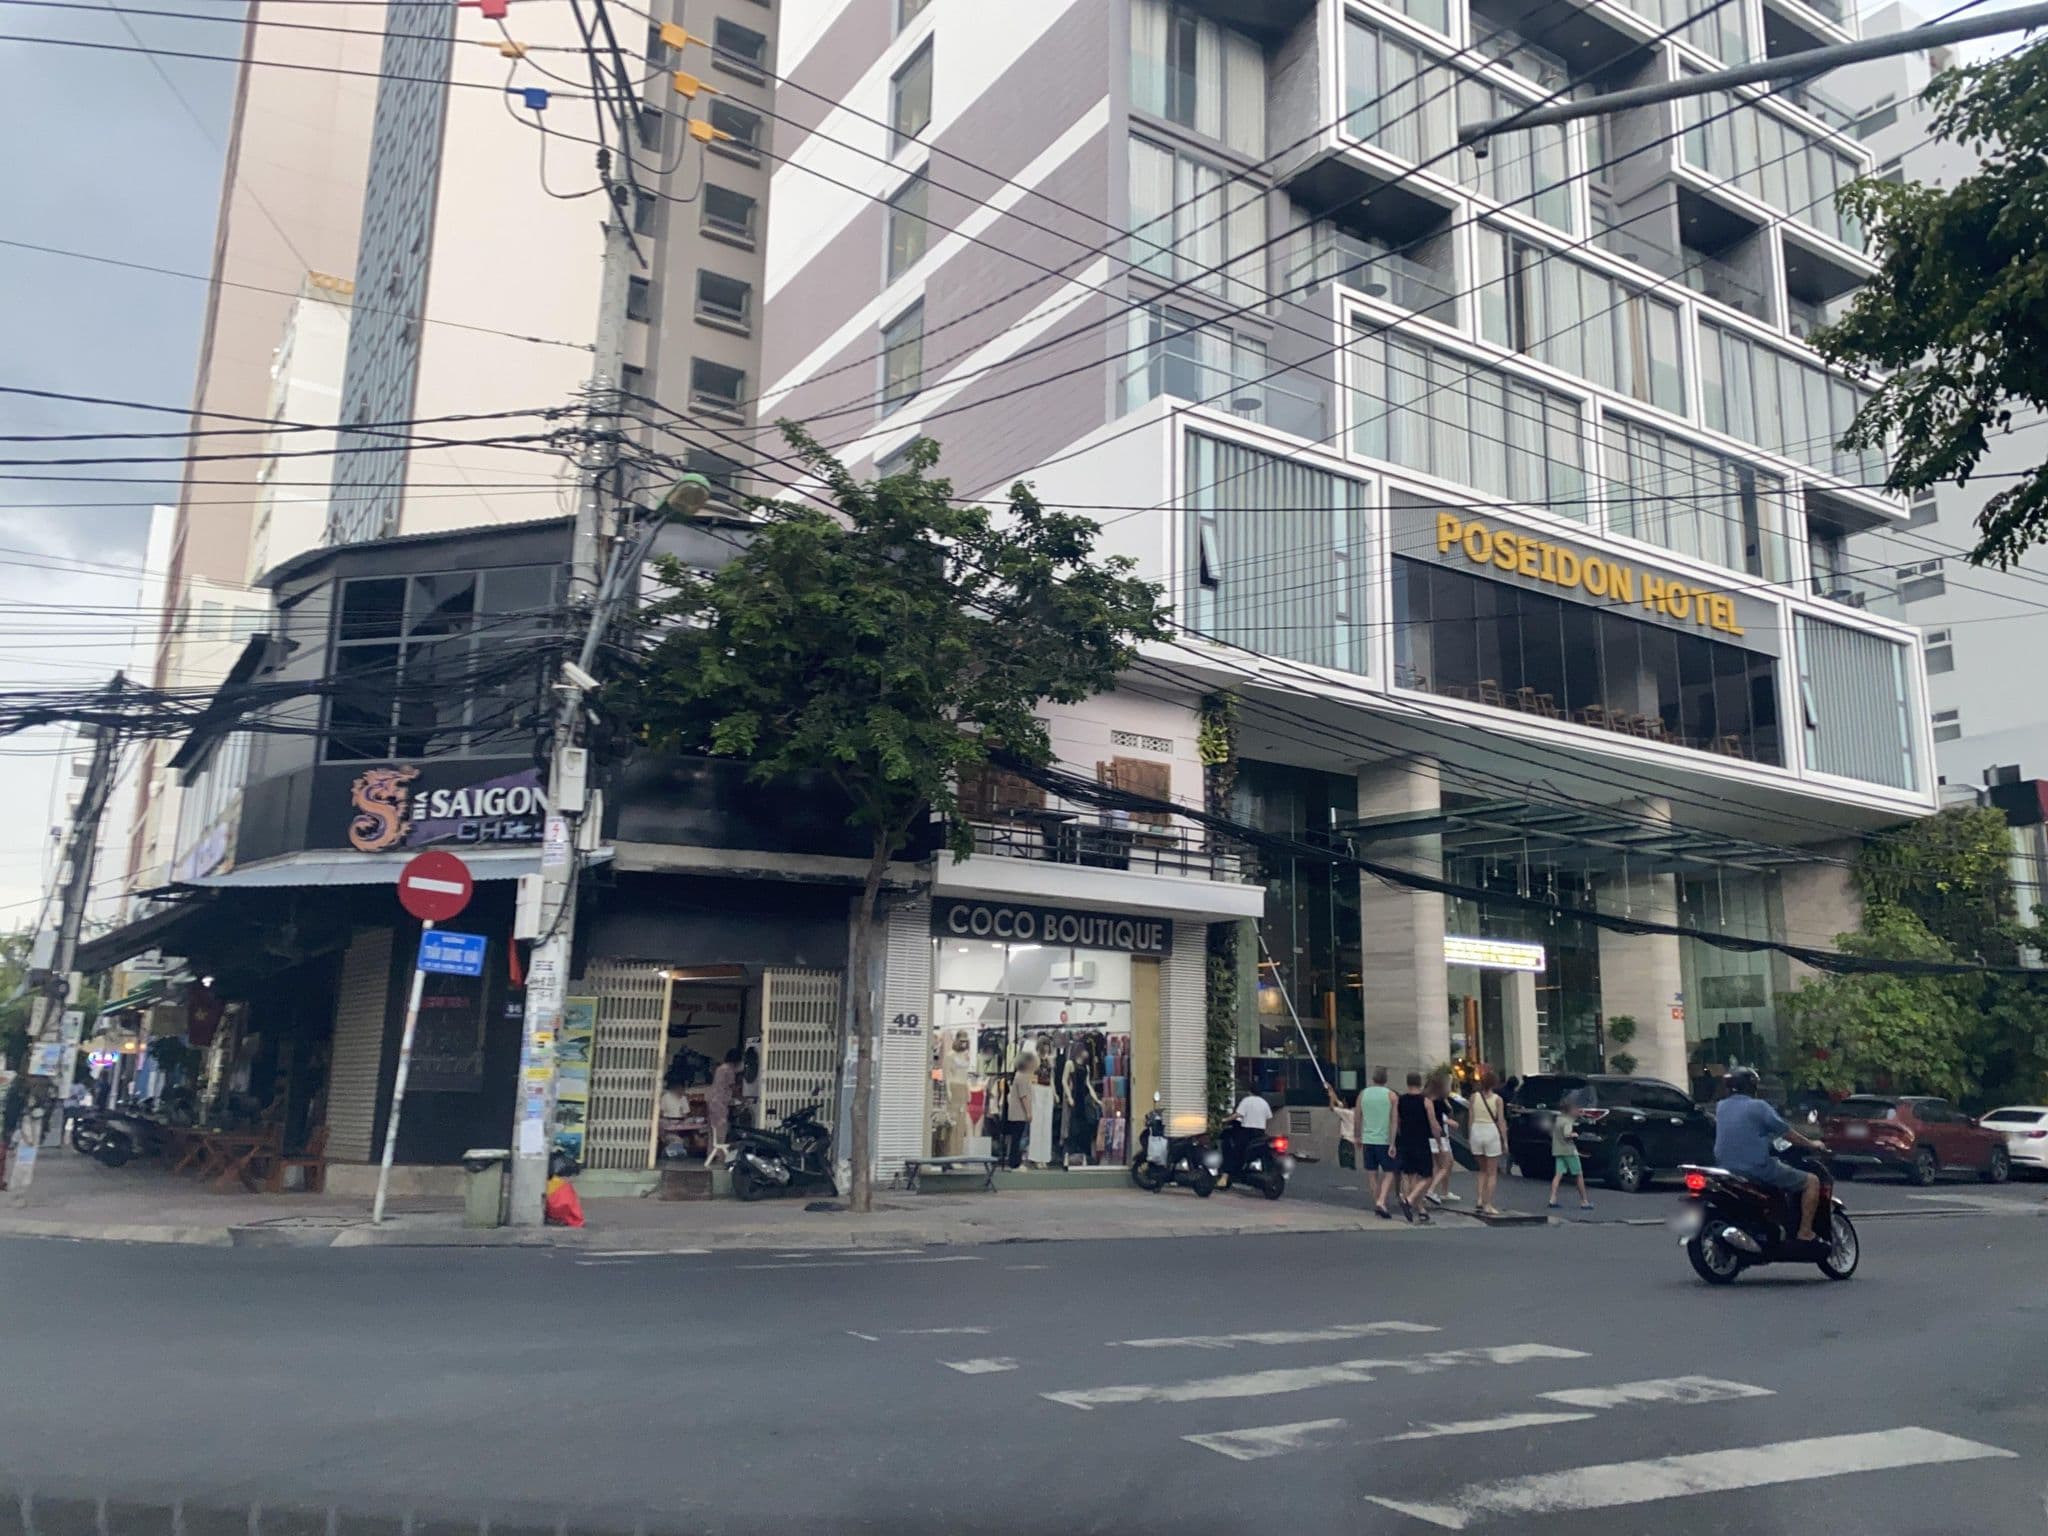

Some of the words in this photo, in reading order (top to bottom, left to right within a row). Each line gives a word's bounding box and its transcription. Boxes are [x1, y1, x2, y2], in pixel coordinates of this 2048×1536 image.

[1437, 512, 1633, 605] POSEIDON
[1641, 572, 1745, 636] HOTEL
[412, 791, 429, 820] BIA
[430, 786, 548, 818] SAIGON
[950, 904, 1036, 939] COCO
[1043, 914, 1163, 951] BOUTIQUE
